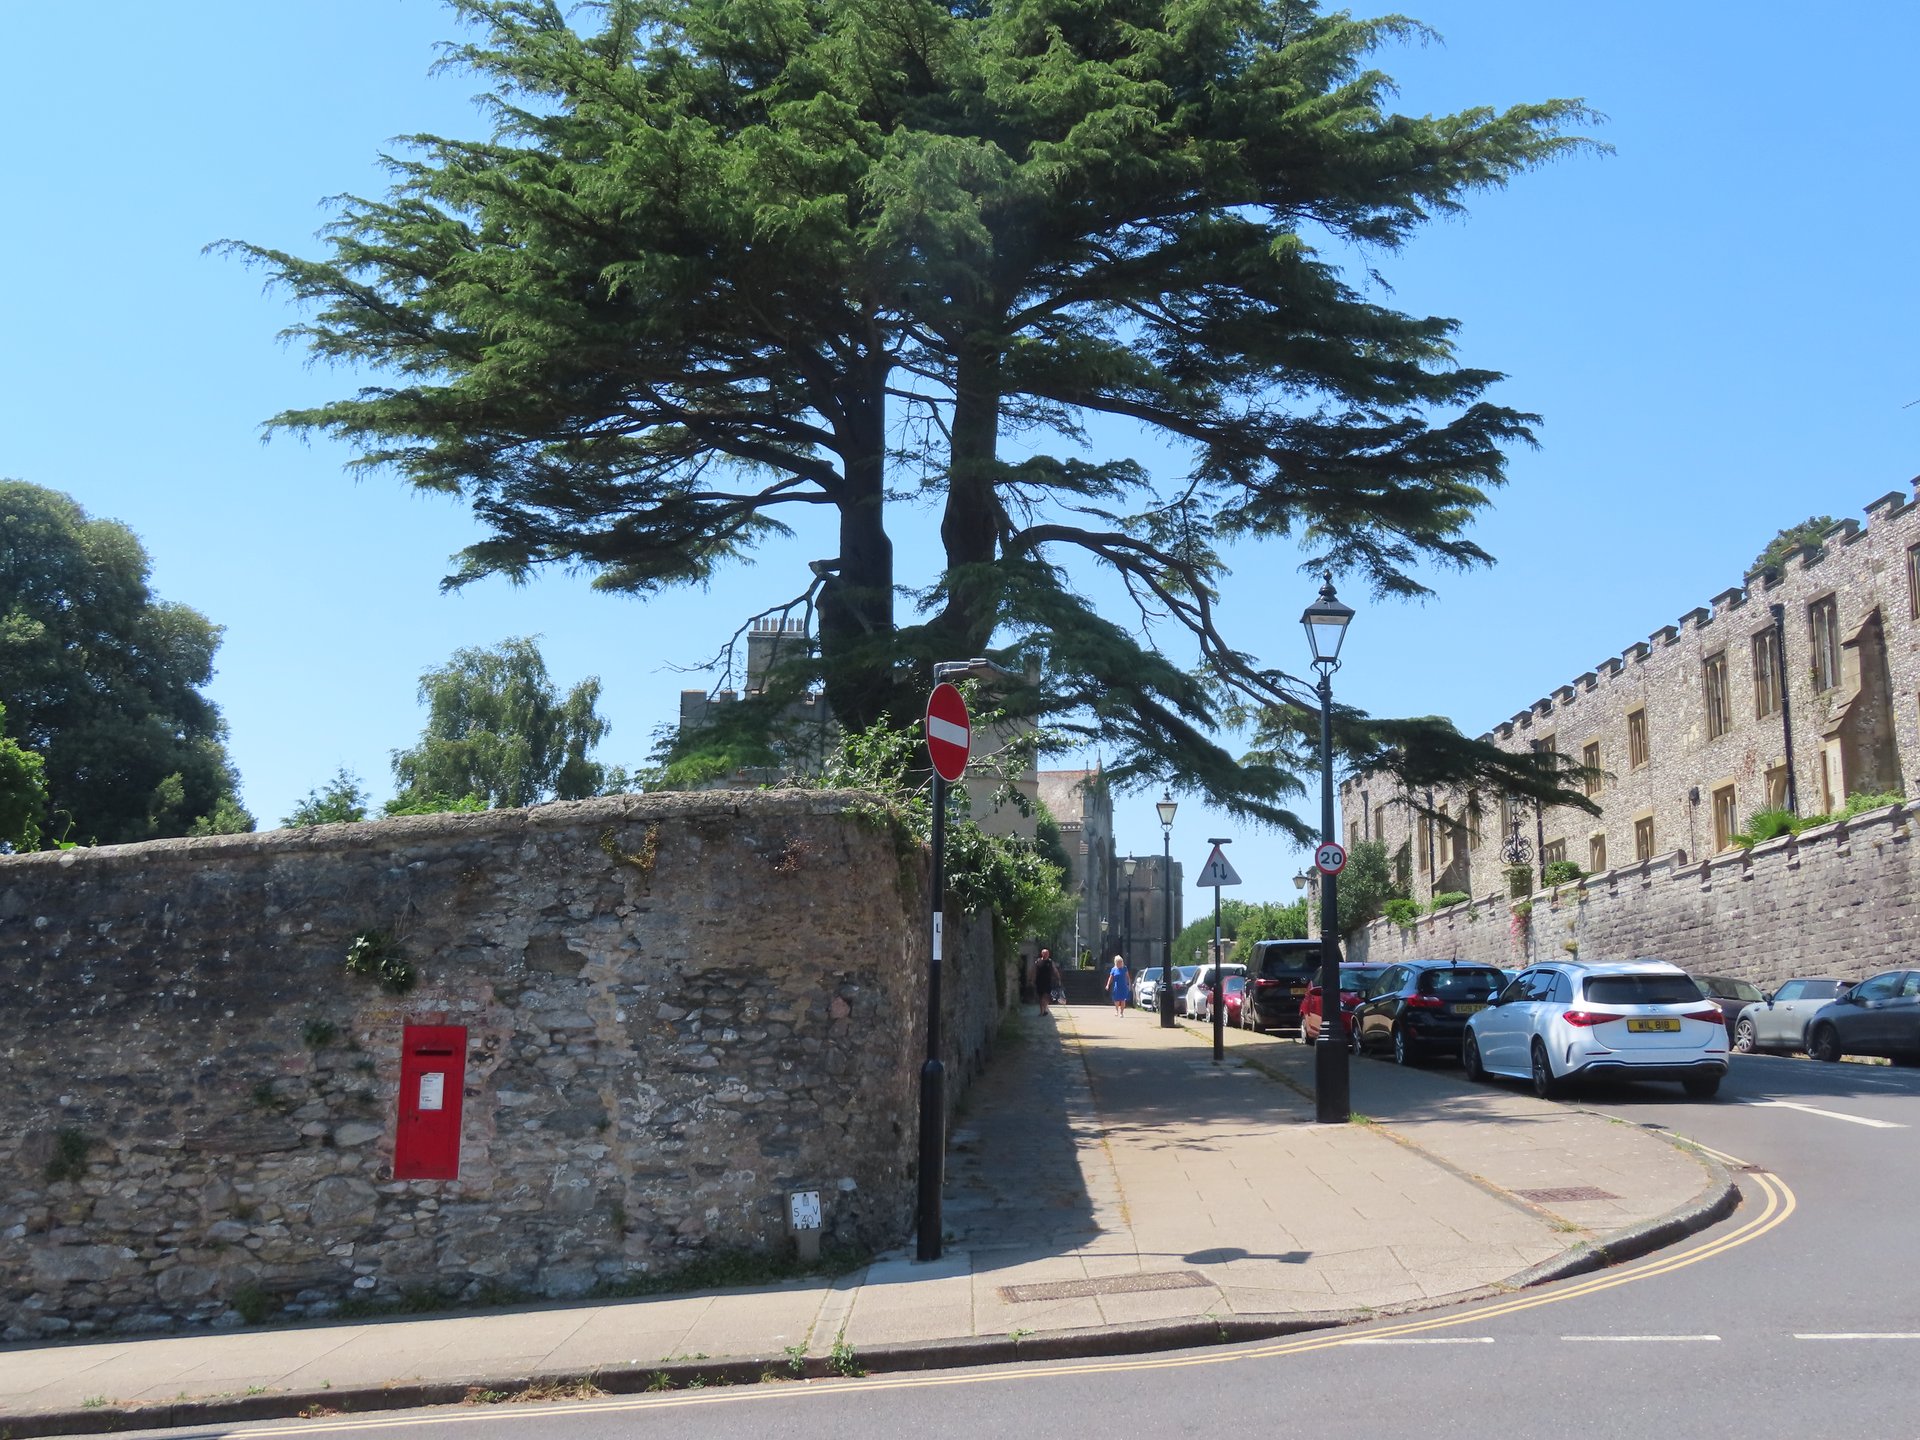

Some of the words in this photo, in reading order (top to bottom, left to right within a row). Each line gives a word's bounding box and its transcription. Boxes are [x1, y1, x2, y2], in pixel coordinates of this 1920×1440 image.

[1320, 851, 1342, 865] 20
[793, 1207, 800, 1218] S
[812, 1205, 819, 1215] V
